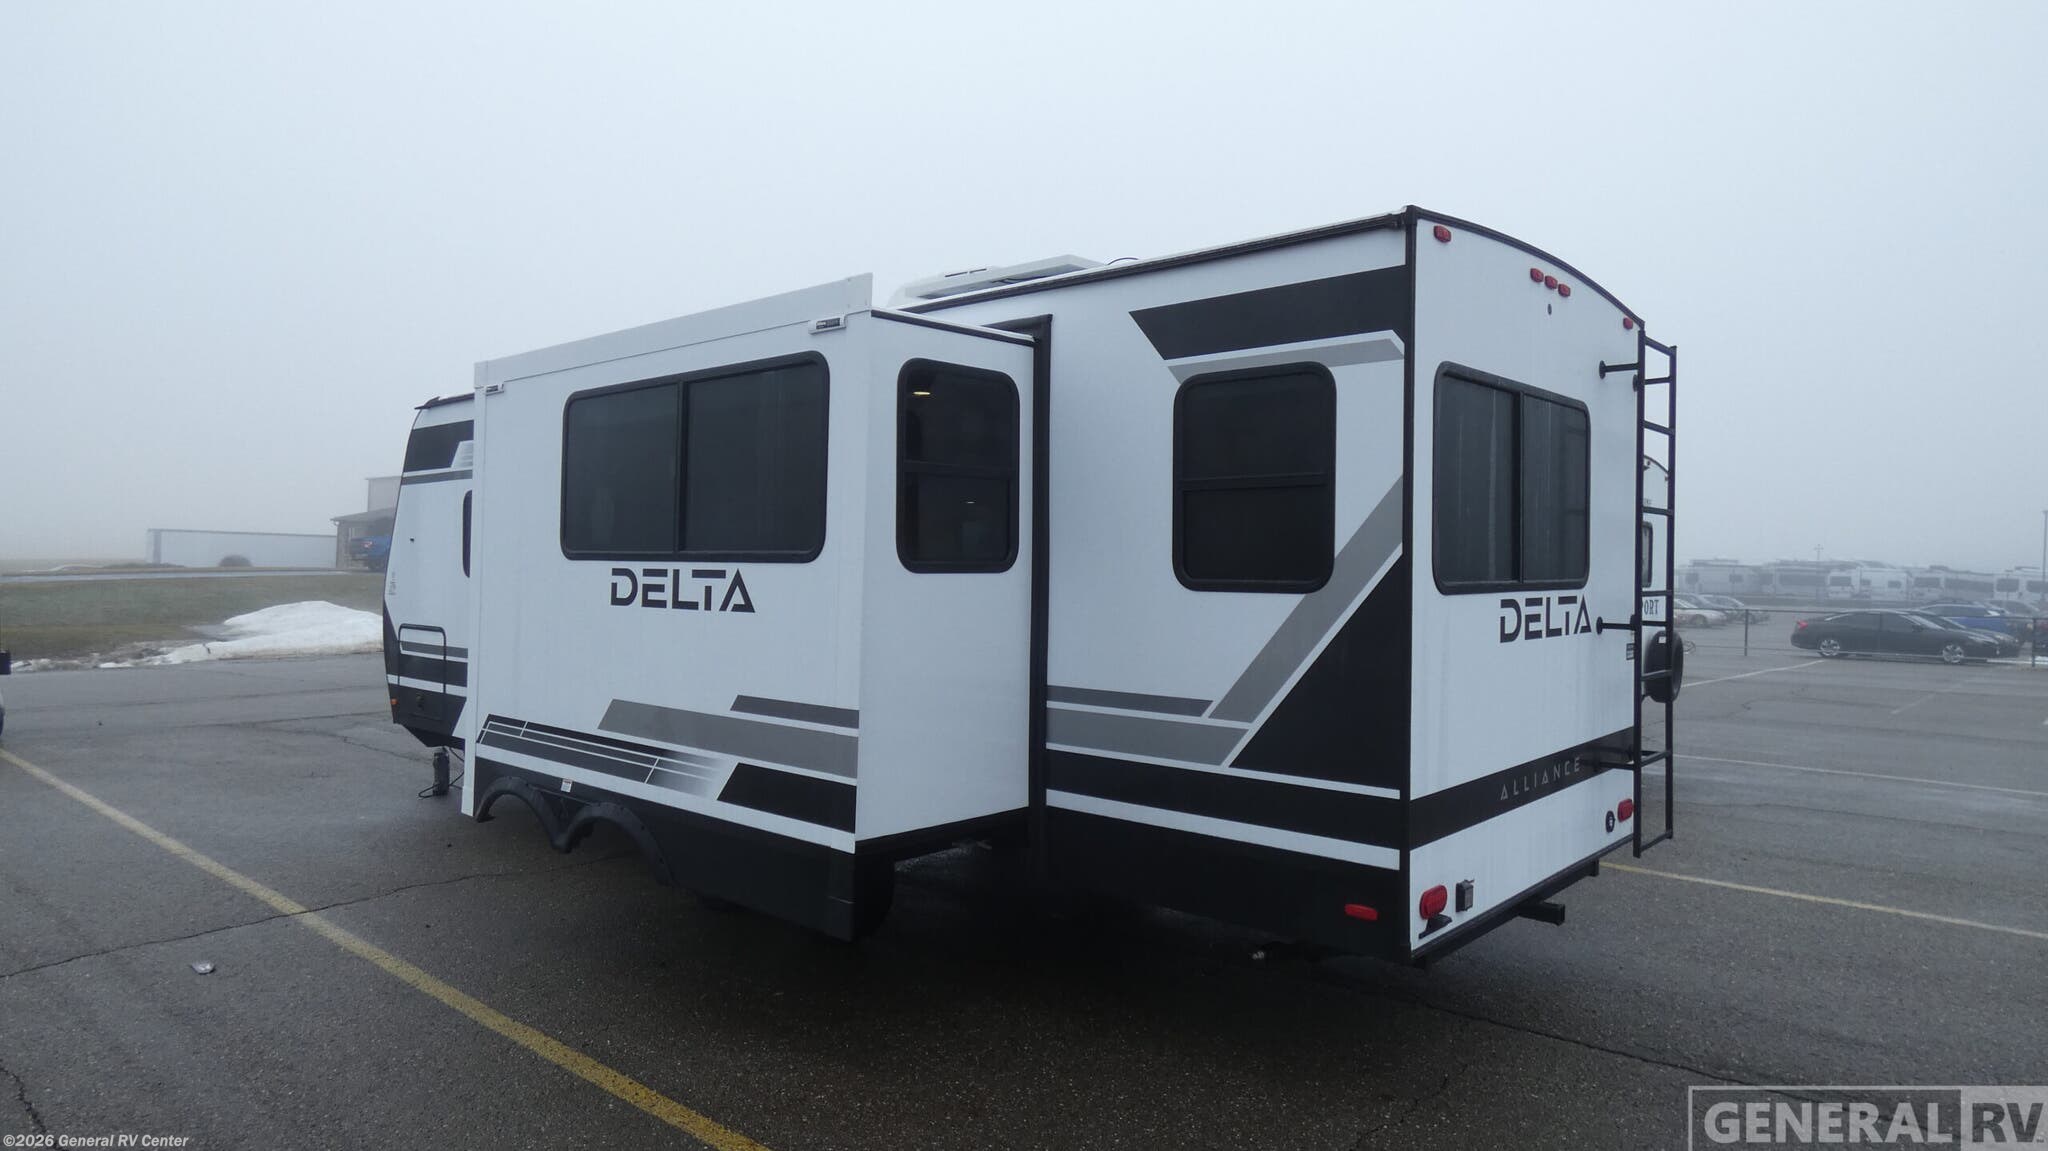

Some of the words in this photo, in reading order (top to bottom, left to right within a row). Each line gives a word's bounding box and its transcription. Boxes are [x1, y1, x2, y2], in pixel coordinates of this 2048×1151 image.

[610, 568, 755, 613] DELTA
[1641, 599, 1659, 615] ORT
[1500, 594, 1592, 643] DELTA
[1500, 756, 1581, 801] ALLIANCE
